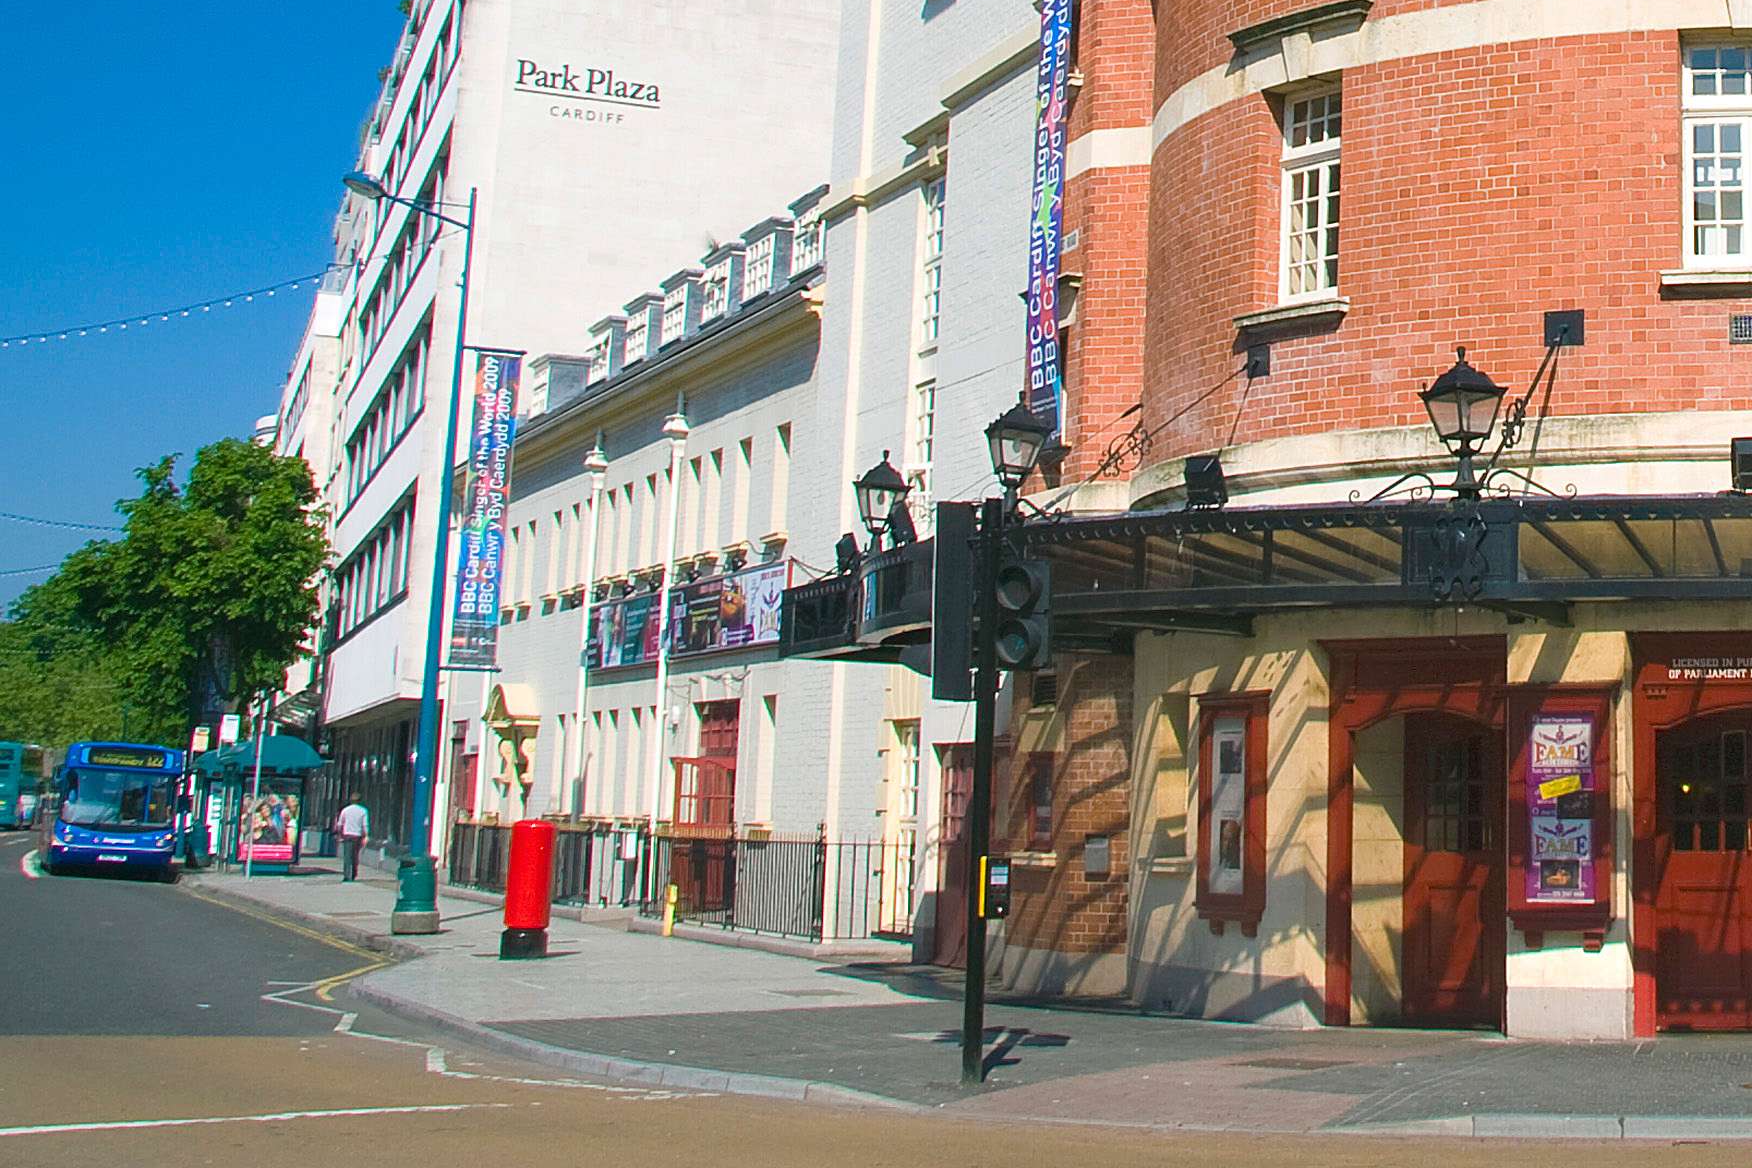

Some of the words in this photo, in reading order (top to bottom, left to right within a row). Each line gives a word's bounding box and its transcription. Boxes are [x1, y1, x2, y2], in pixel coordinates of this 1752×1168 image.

[1040, 29, 1053, 76] the
[515, 59, 580, 92] Park
[586, 68, 661, 102] Plaza
[1039, 84, 1051, 109] of
[550, 106, 625, 124] CARDIFF
[1034, 118, 1050, 212] Singer
[1048, 130, 1064, 187] Byd
[1048, 193, 1061, 209] y
[1030, 217, 1045, 317] Cardiff
[1044, 220, 1058, 310] Canwr
[1030, 324, 1044, 390] BBC
[1044, 319, 1057, 385] BBC
[483, 356, 499, 390] 2009
[478, 394, 497, 435] World
[496, 388, 512, 420] 2009
[476, 437, 491, 459] the
[490, 423, 511, 489] Caerdydd
[475, 462, 488, 477] of
[470, 479, 489, 529] Singer
[487, 490, 505, 519] Byd
[489, 520, 503, 531] y
[464, 531, 481, 579] Cardiff
[481, 532, 499, 579] Canwr
[461, 582, 477, 613] BBC
[478, 582, 494, 614] BBC
[1668, 669, 1681, 680] OF
[1684, 669, 1746, 679] PARLIAMENT
[1672, 658, 1719, 668] LICENSED
[1722, 658, 1733, 667] IN
[1534, 740, 1588, 763] FAME
[1534, 834, 1588, 856] FAME
